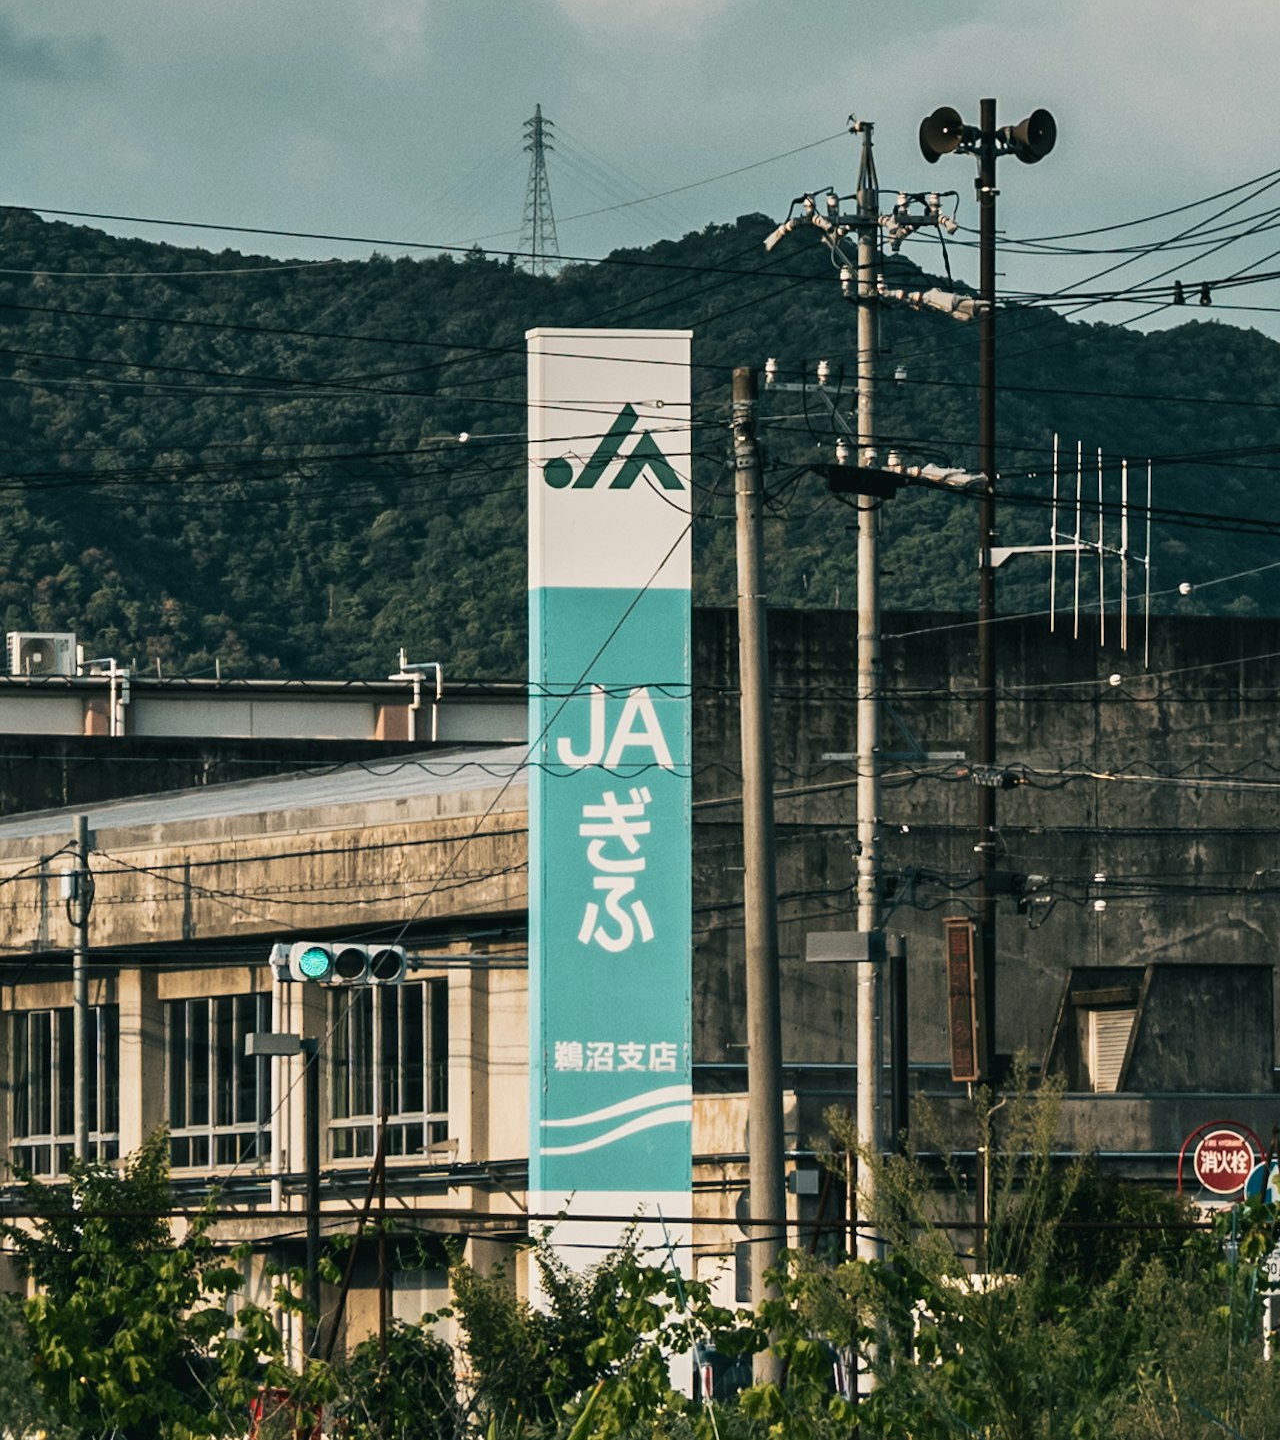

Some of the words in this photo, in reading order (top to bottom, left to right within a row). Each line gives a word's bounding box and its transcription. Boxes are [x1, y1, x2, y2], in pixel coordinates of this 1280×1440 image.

[557, 684, 675, 769] JA
[578, 786, 654, 952] ぎふ
[1200, 1150, 1249, 1174] 消火栓
